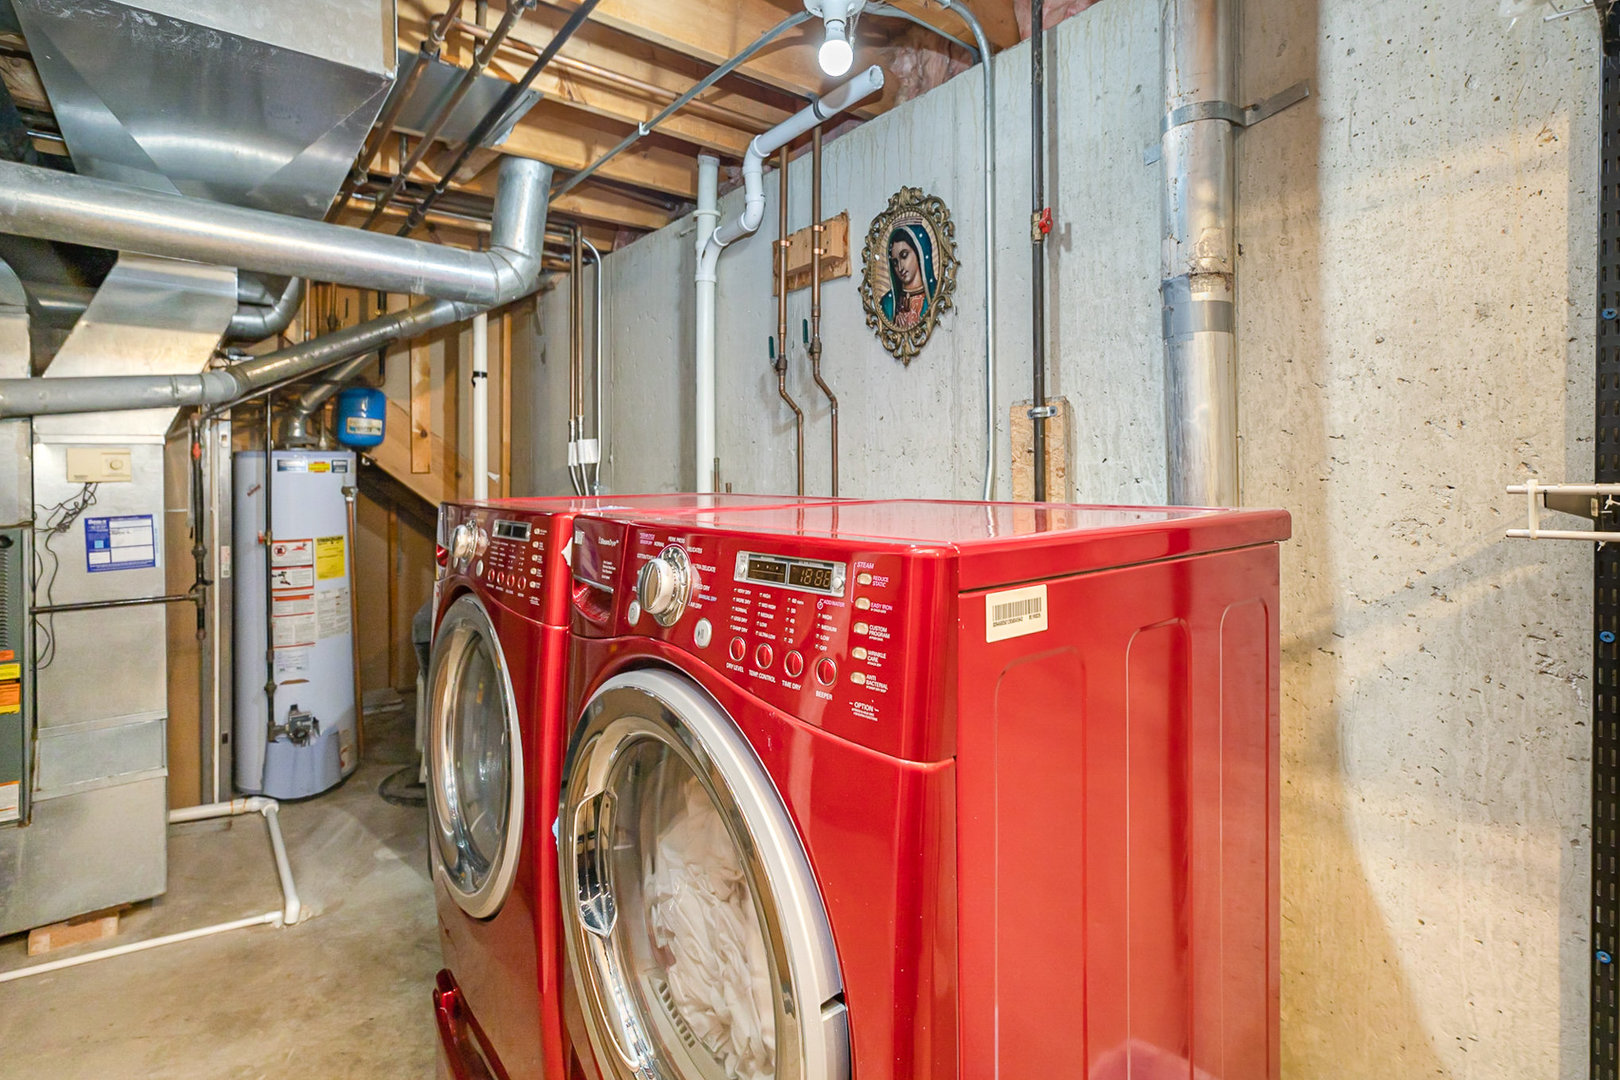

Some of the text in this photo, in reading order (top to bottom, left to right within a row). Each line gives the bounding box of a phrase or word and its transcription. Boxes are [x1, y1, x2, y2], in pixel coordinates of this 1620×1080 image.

[856, 561, 875, 569] STEAM
[872, 575, 889, 583] REDUCE
[872, 580, 887, 588] STATIC
[869, 624, 888, 632] CUSTOM
[869, 630, 891, 639] PROGRAM
[867, 650, 887, 659] WRINKLE
[867, 655, 879, 663] CARE
[733, 664, 745, 673] LEVEL
[758, 672, 776, 684] CONTROL
[782, 680, 792, 688] TIME
[866, 680, 888, 691] BACTERIAL
[815, 690, 833, 700] BEEPER
